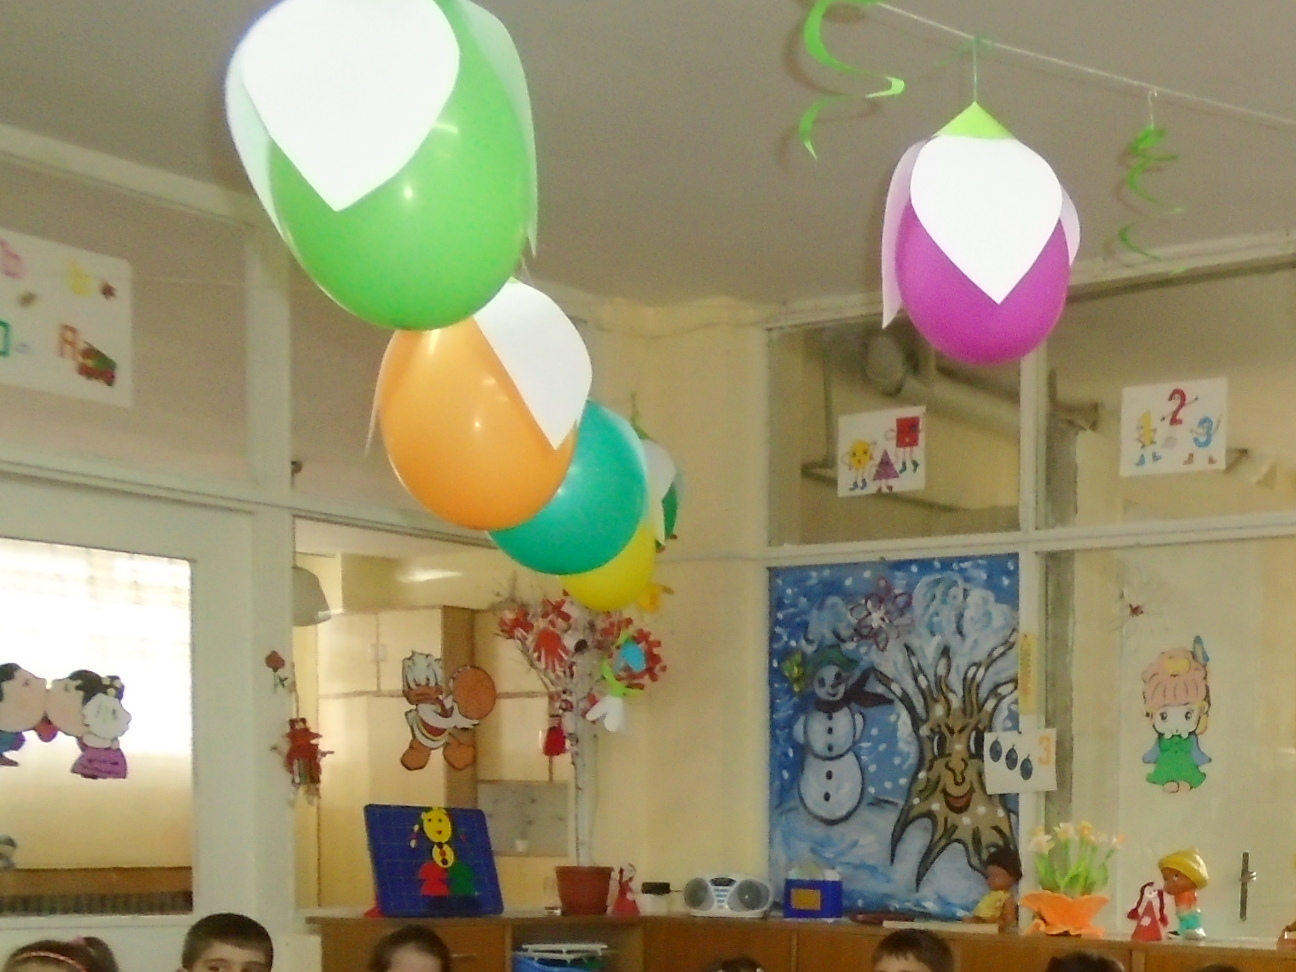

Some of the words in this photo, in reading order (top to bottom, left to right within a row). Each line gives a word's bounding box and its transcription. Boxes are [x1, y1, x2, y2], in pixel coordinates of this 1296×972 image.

[1168, 387, 1186, 426] 2
[1193, 415, 1213, 448] 3
[1037, 735, 1053, 766] 3
